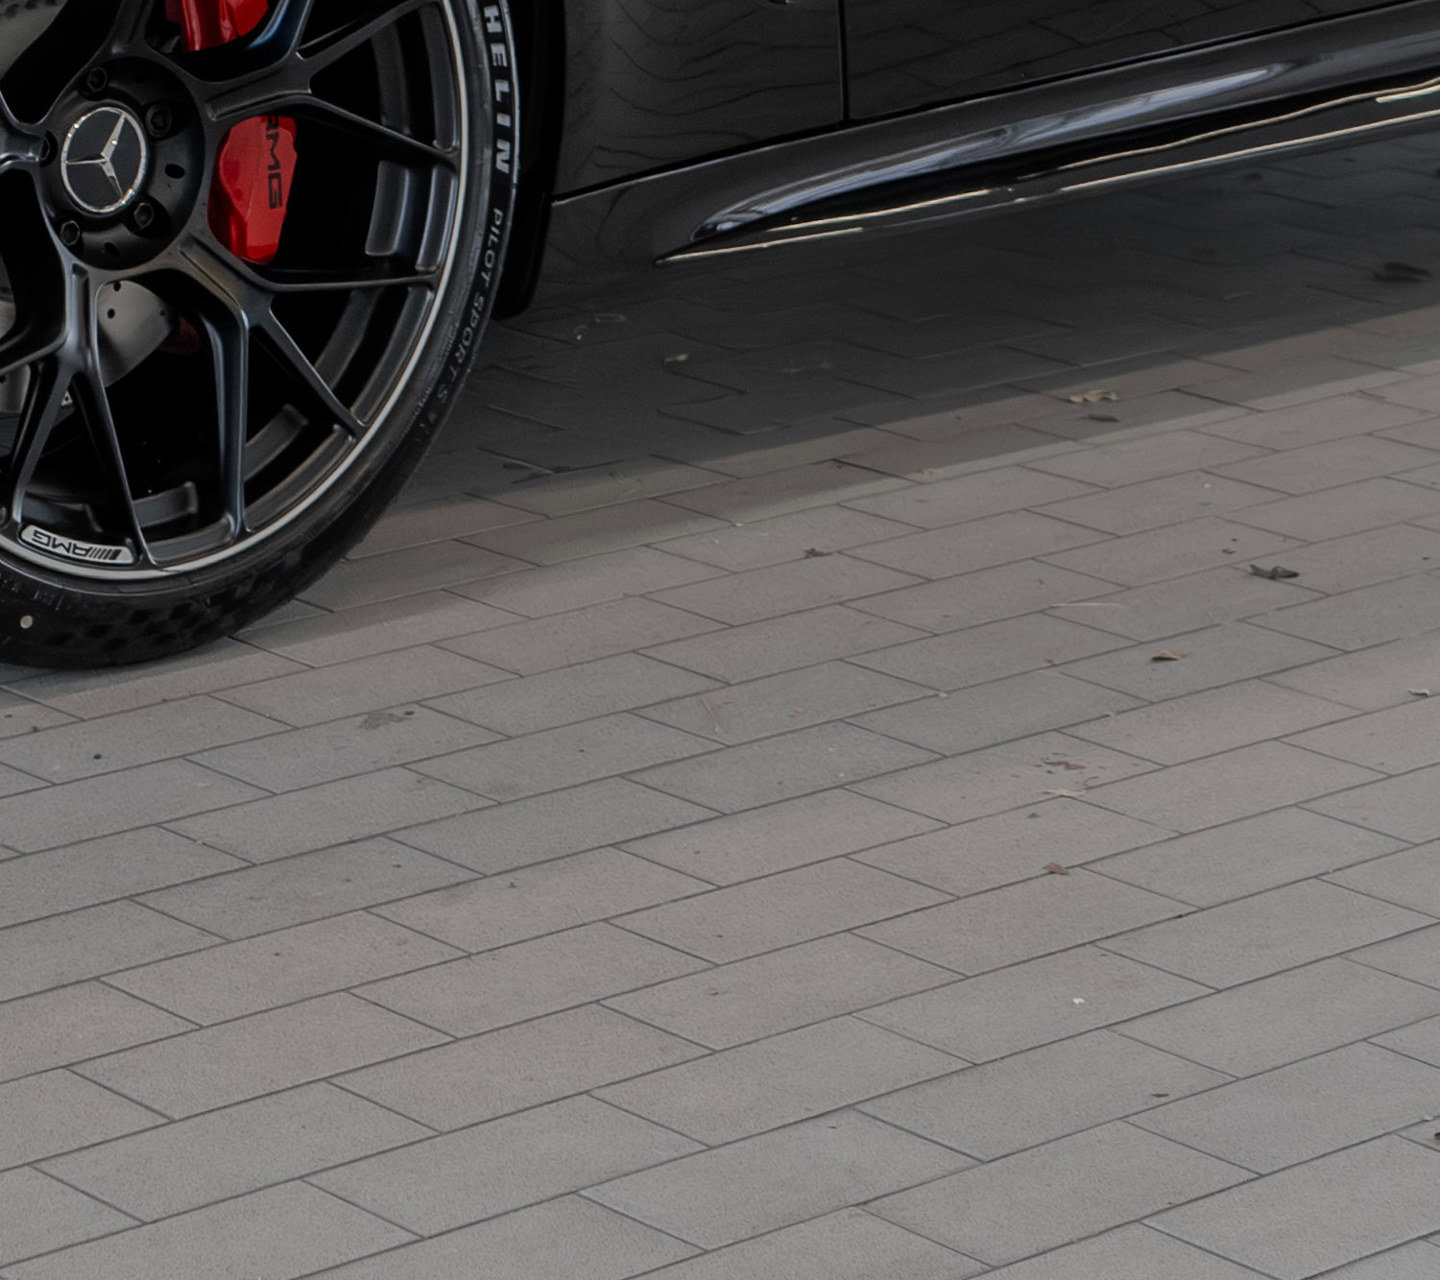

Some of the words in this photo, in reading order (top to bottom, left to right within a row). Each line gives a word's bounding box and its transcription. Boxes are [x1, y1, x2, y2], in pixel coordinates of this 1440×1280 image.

[481, 207, 504, 285] PILOT
[449, 295, 485, 375] SPORT
[32, 529, 92, 557] AMG
